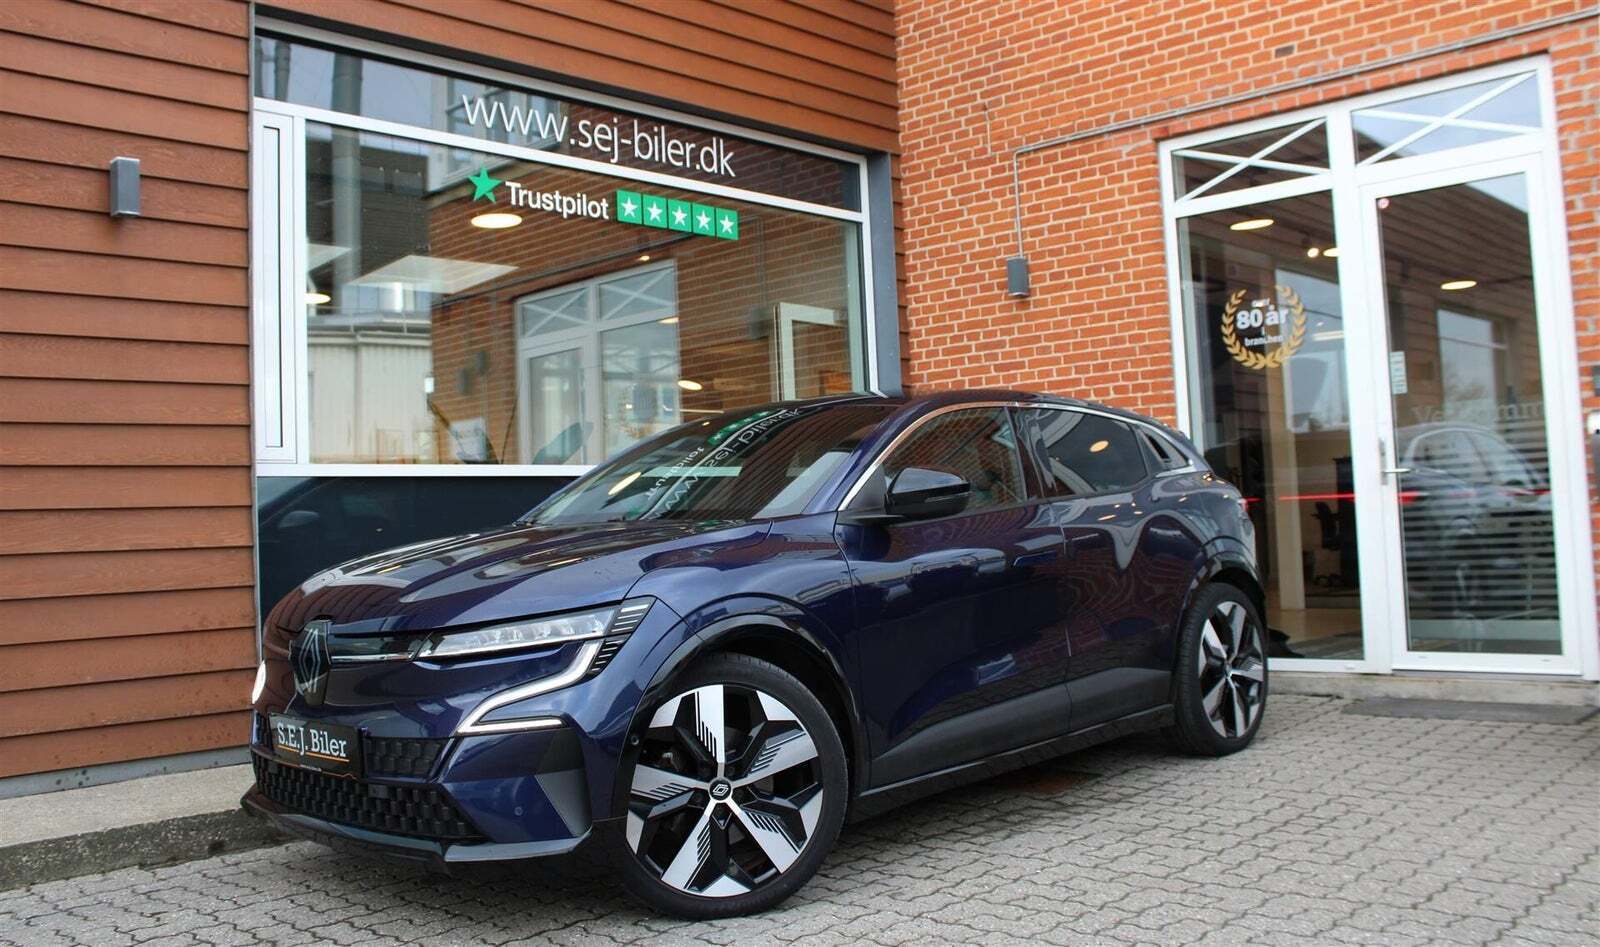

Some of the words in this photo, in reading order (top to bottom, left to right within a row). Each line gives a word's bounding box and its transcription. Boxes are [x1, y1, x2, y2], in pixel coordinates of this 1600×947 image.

[463, 94, 736, 177] www.sej-biler.dk
[505, 181, 609, 220] Trustpilot
[1236, 308, 1263, 329] 80
[1265, 304, 1289, 325] år
[277, 722, 308, 756] S.E.J.
[310, 728, 347, 758] Biler
